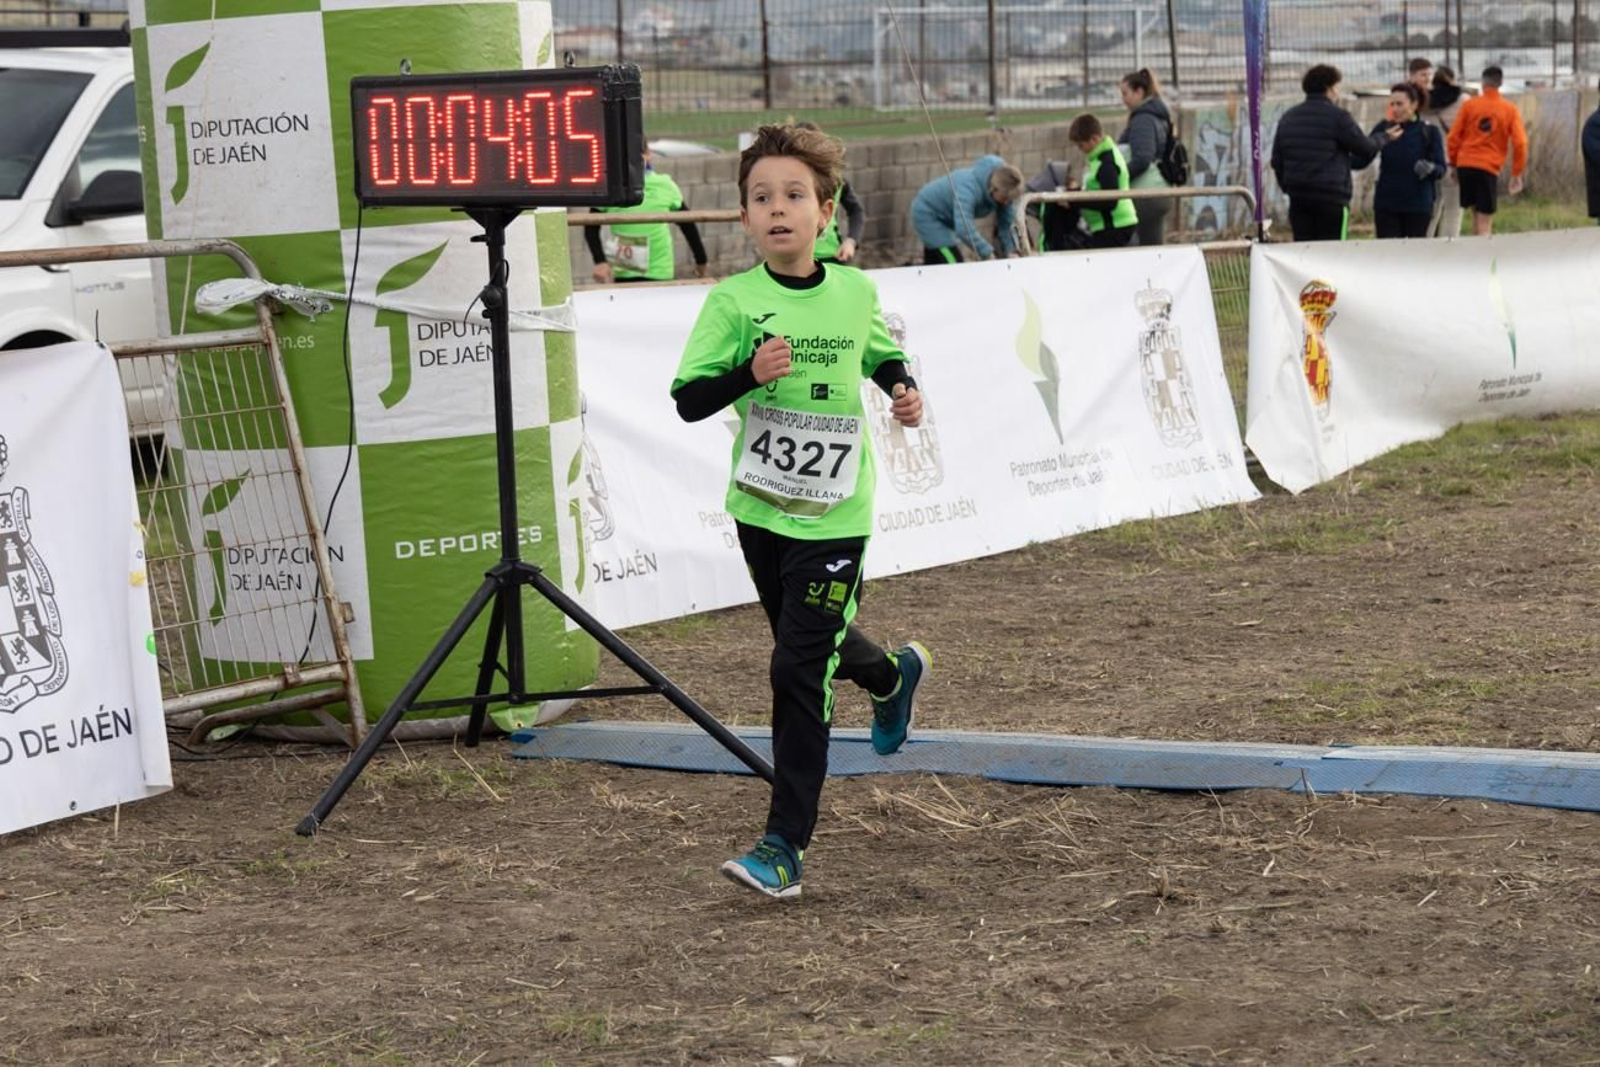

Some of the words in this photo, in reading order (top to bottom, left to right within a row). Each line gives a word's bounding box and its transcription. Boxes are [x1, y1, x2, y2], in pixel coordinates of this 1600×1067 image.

[190, 112, 309, 139] DIPUTACIÓN
[369, 90, 601, 184] 00:04:05
[193, 147, 216, 165] DE
[218, 141, 267, 164] JAÉN
[417, 320, 491, 341] DIPUTA
[419, 349, 447, 367] DE
[750, 429, 852, 478] 4327
[744, 472, 804, 497] RODRIGUEZ
[699, 510, 732, 530] Patro
[878, 507, 925, 533] CIUDAD
[925, 505, 945, 526] DE
[944, 497, 978, 522] JAÉN
[229, 545, 344, 565] DPUTACIN
[395, 525, 542, 559] DEPORES
[617, 549, 658, 576] JAÉN
[255, 570, 302, 591] JAÉN
[20, 724, 60, 759] DE
[66, 704, 133, 749] JAÉN
